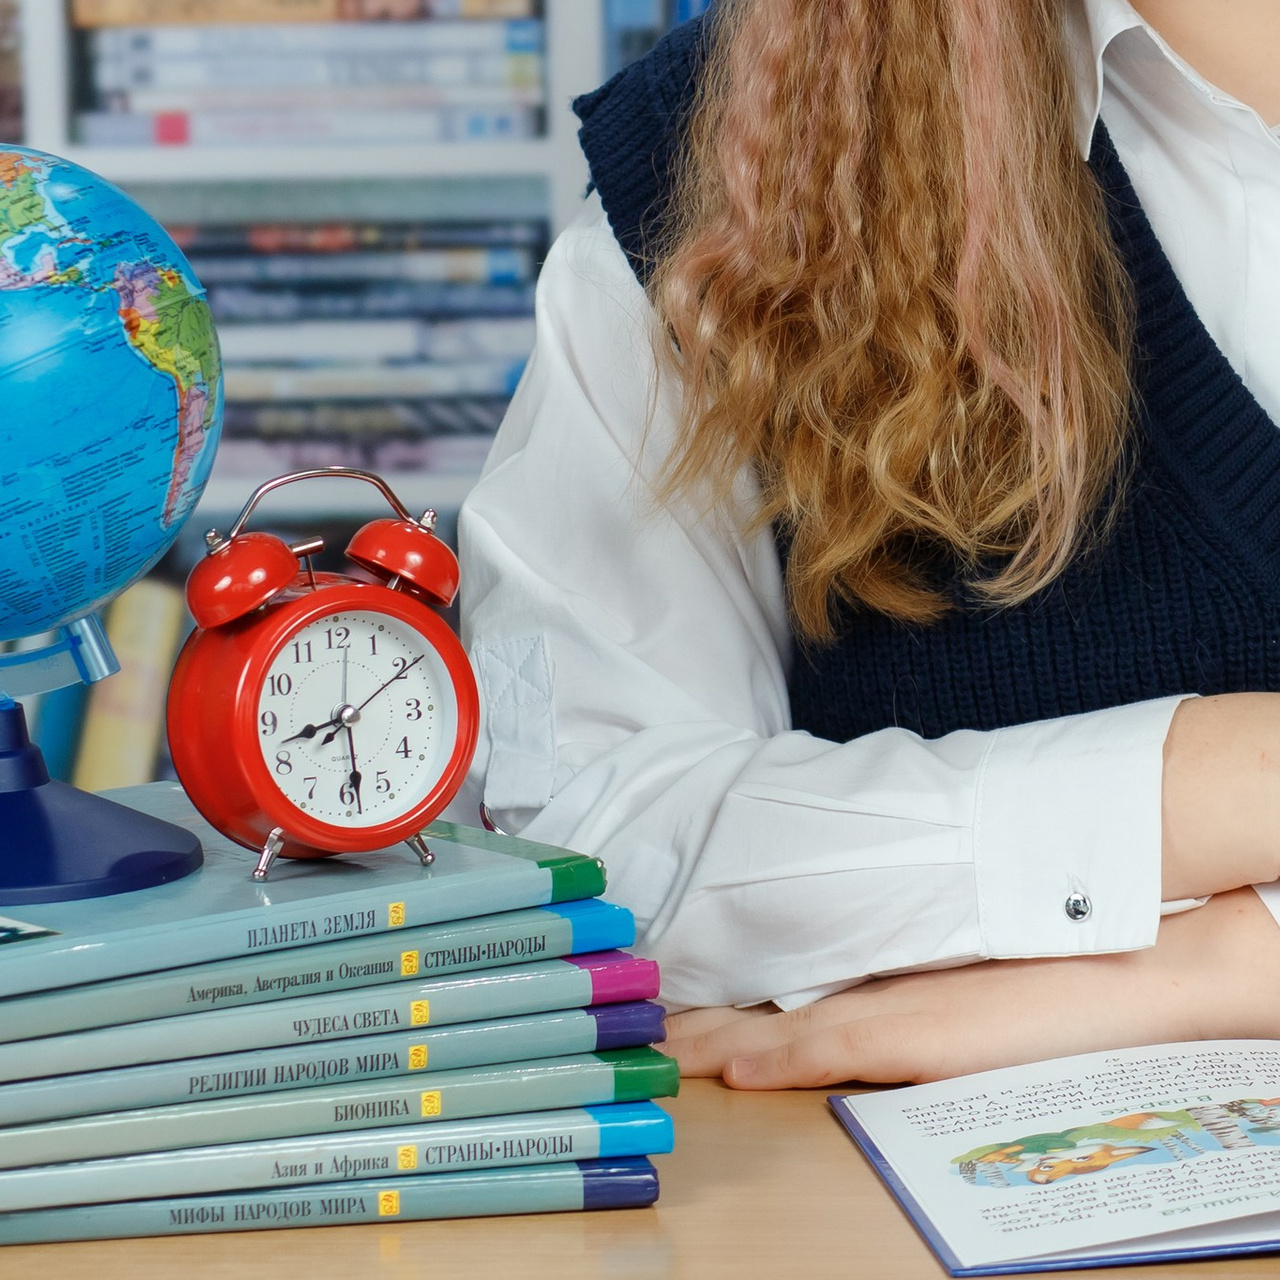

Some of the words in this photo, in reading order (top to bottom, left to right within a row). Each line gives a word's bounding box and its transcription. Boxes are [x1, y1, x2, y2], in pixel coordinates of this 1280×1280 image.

[324, 626, 351, 649] 12
[368, 633, 379, 656] 1
[291, 640, 315, 663] 11
[392, 656, 408, 680] 2
[268, 673, 292, 696] 10
[405, 697, 422, 721] 3
[260, 710, 278, 736] 9
[331, 753, 359, 762] QUARZ
[395, 736, 412, 759] 4
[275, 750, 292, 775] 8
[303, 776, 318, 800] 7
[339, 781, 355, 805] 6
[375, 770, 391, 793] 5
[247, 920, 317, 948] ПЛАНЕТА
[324, 909, 376, 935] ЗЕМЛЯ
[253, 970, 321, 993] Австралия
[326, 970, 334, 981] и
[339, 960, 394, 979] Океания
[293, 1015, 349, 1038] ЧУДЕСА
[353, 1008, 400, 1030] СВЕТА
[189, 1067, 267, 1094] РЕЛИГИИ
[273, 1058, 349, 1084] НАРОДОВ
[355, 1052, 399, 1074] МИРА
[334, 1099, 409, 1122] БИОНИКА
[271, 1160, 308, 1179] Азия
[314, 1162, 323, 1173] и
[329, 1154, 389, 1178] Африка
[169, 1205, 225, 1225] МИФЫ
[234, 1200, 311, 1222] НАРОДОВ
[319, 1197, 366, 1215] МИРА
